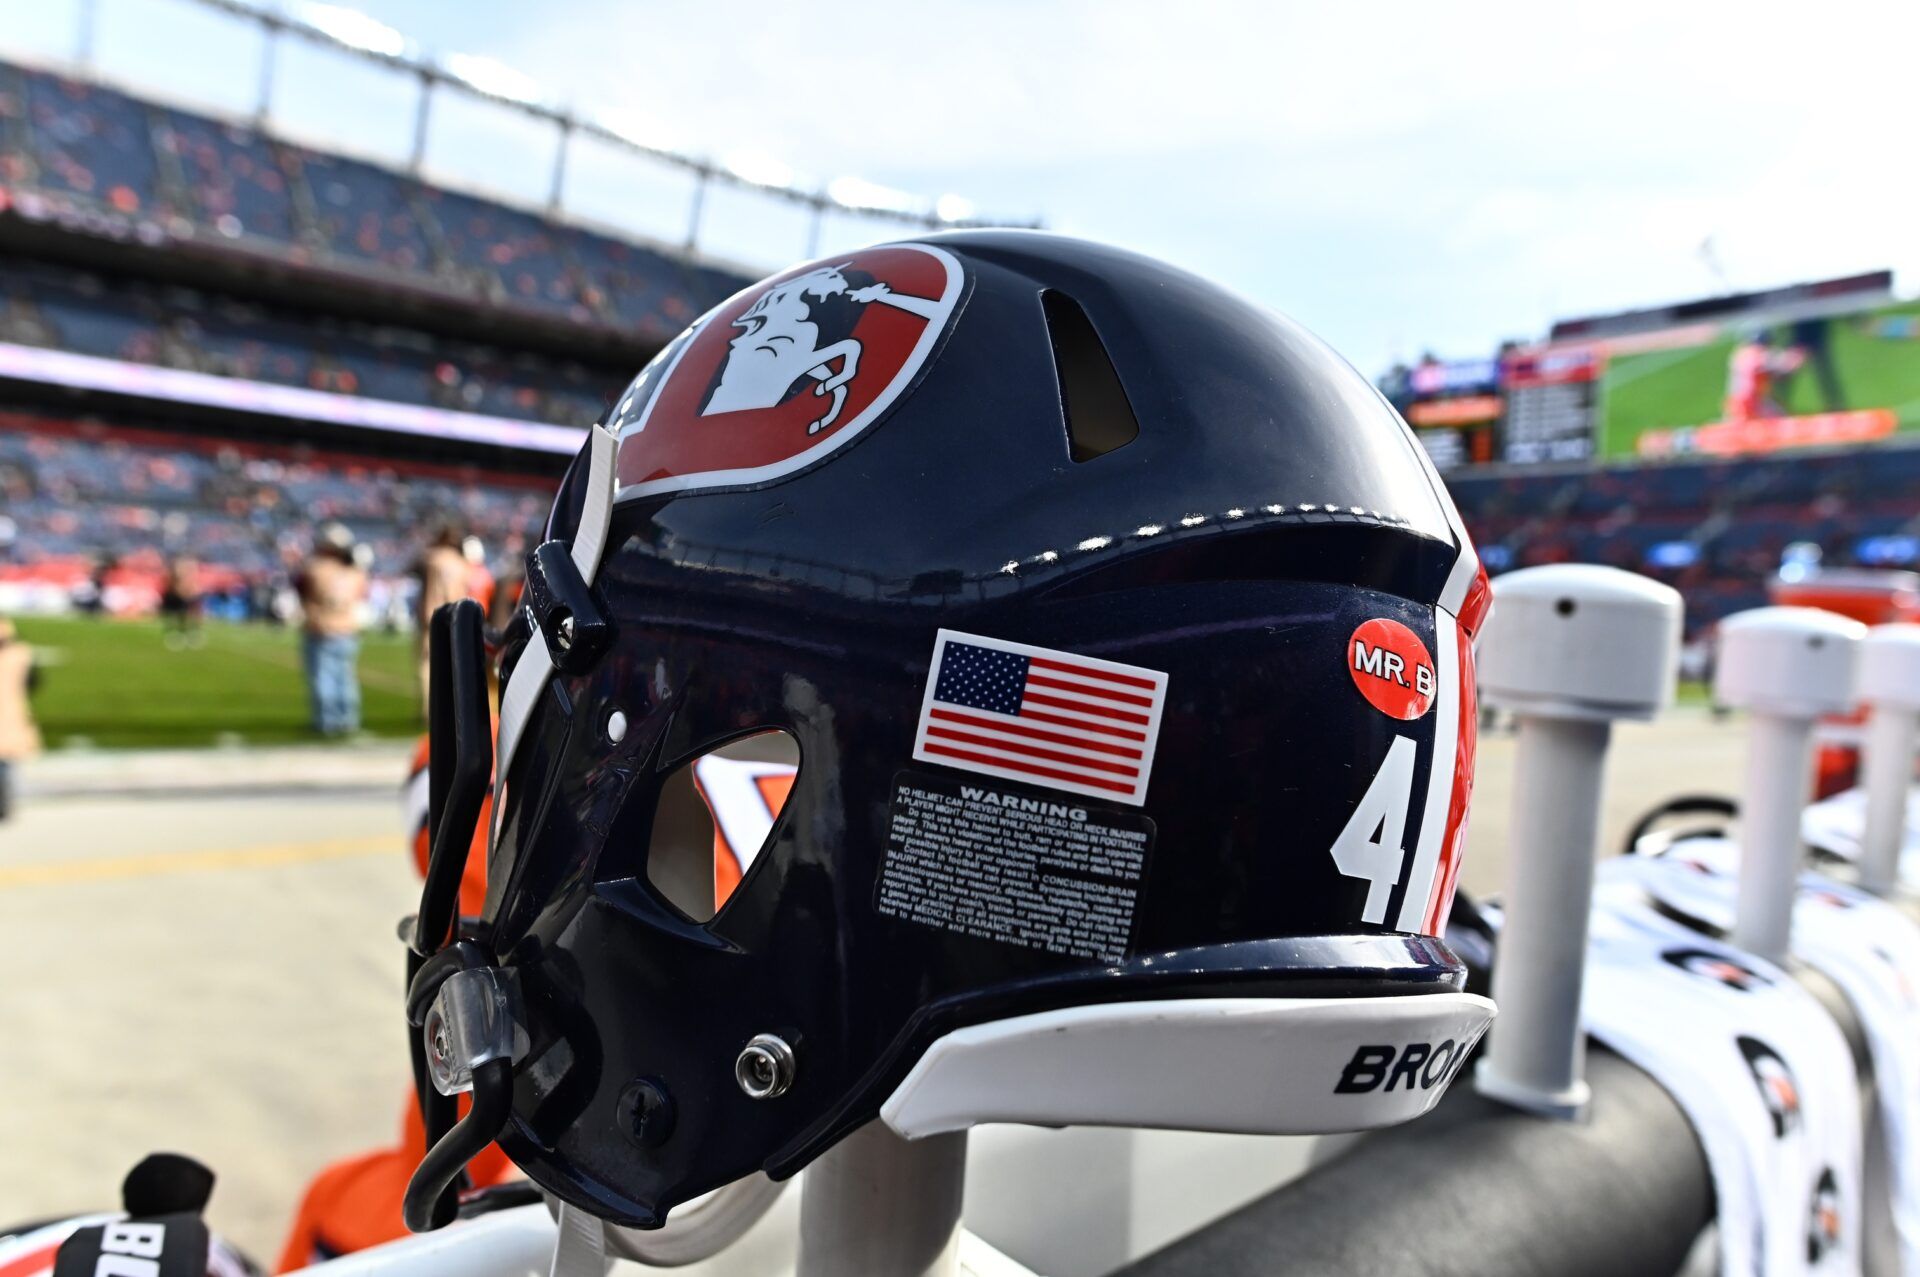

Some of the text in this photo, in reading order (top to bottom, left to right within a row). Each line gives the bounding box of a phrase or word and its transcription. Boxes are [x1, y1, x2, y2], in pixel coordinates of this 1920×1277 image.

[1354, 639, 1433, 697] MR. B
[903, 796, 934, 810] PLAYER
[934, 803, 960, 816] MIGHT
[961, 809, 997, 823] RECEIVE
[998, 817, 1025, 829] WHILE
[1026, 822, 1088, 841] PARTICIPATING
[911, 788, 944, 802] HELMET
[964, 800, 1003, 815] PREVENT
[1004, 808, 1041, 823] SERIOUS
[1044, 816, 1068, 827] HEAD
[1084, 823, 1107, 835] NECK
[1108, 828, 1147, 842] INJURIES
[961, 786, 1088, 820] WARNING
[1330, 735, 1417, 924] 4
